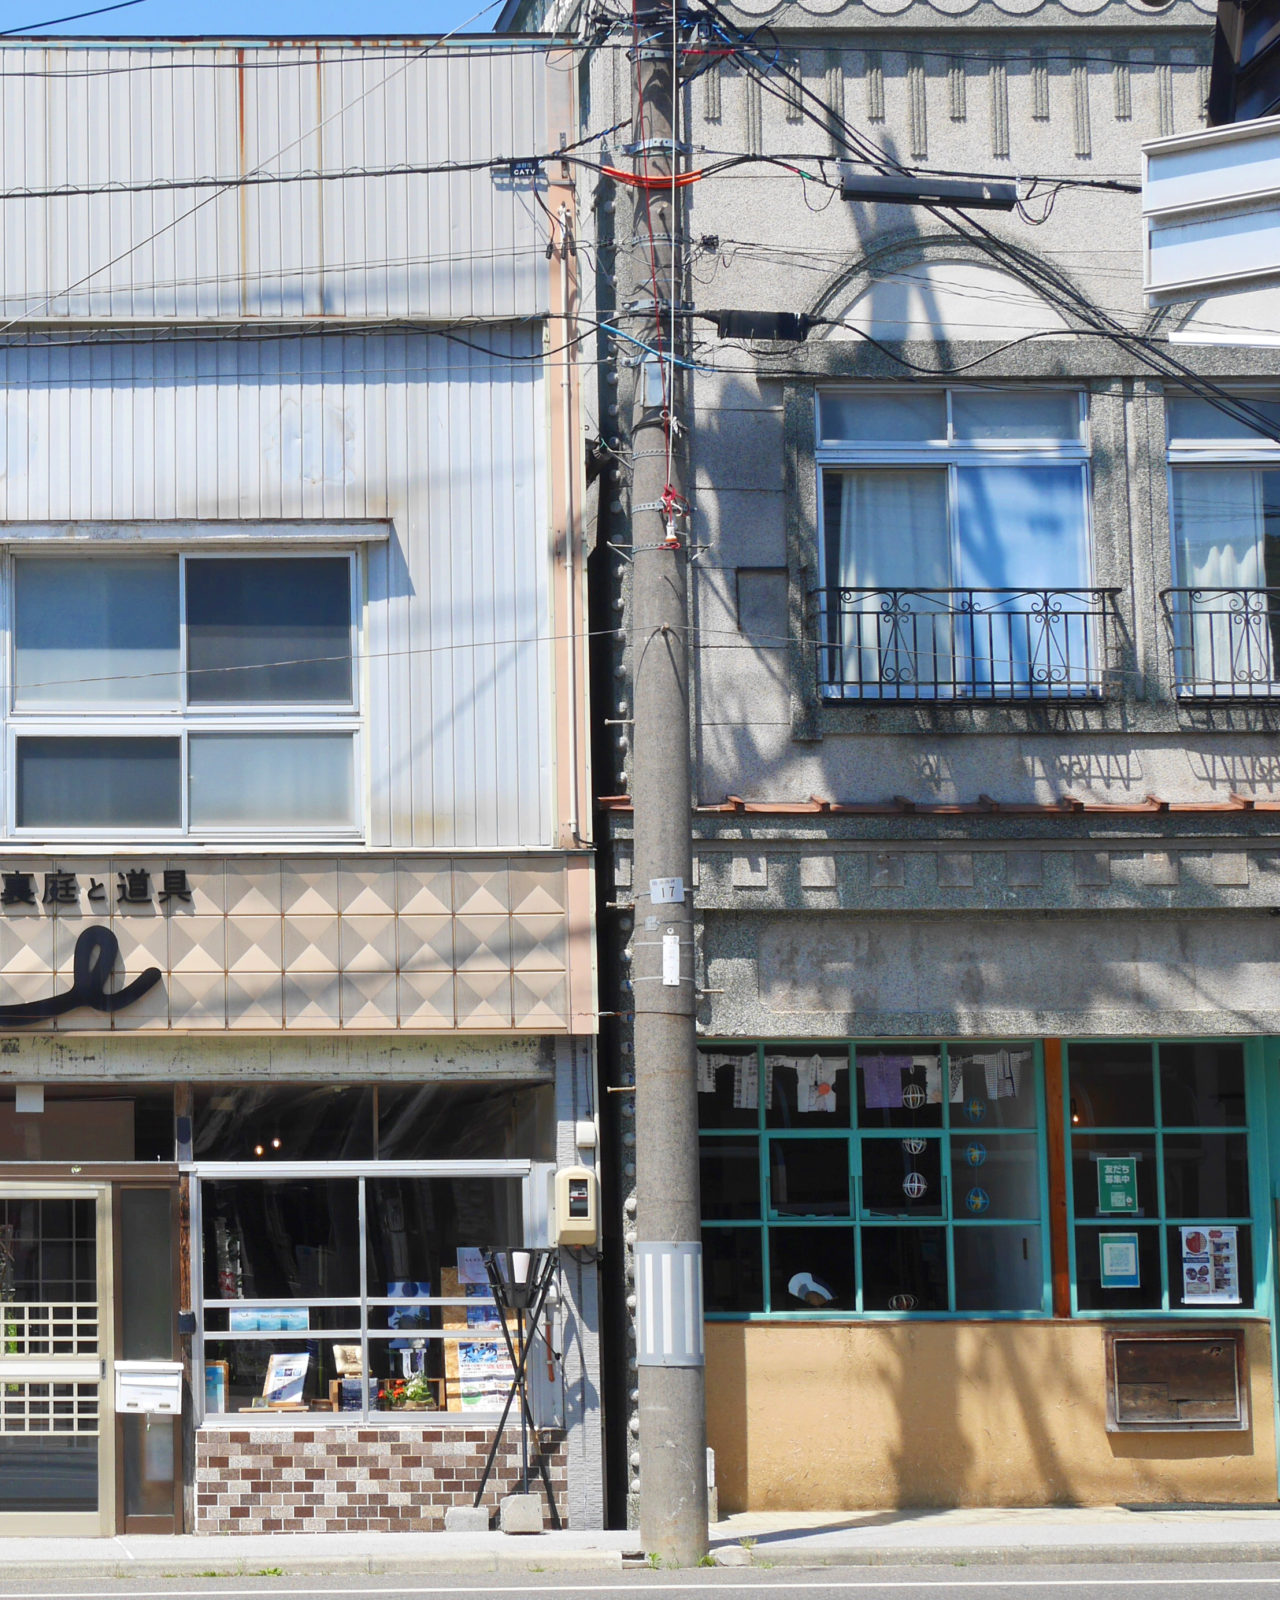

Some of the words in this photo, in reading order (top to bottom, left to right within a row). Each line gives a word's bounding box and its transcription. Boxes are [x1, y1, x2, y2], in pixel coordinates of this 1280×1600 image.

[1104, 1165, 1129, 1173] 友だち
[1105, 1175, 1130, 1184] 募集中
